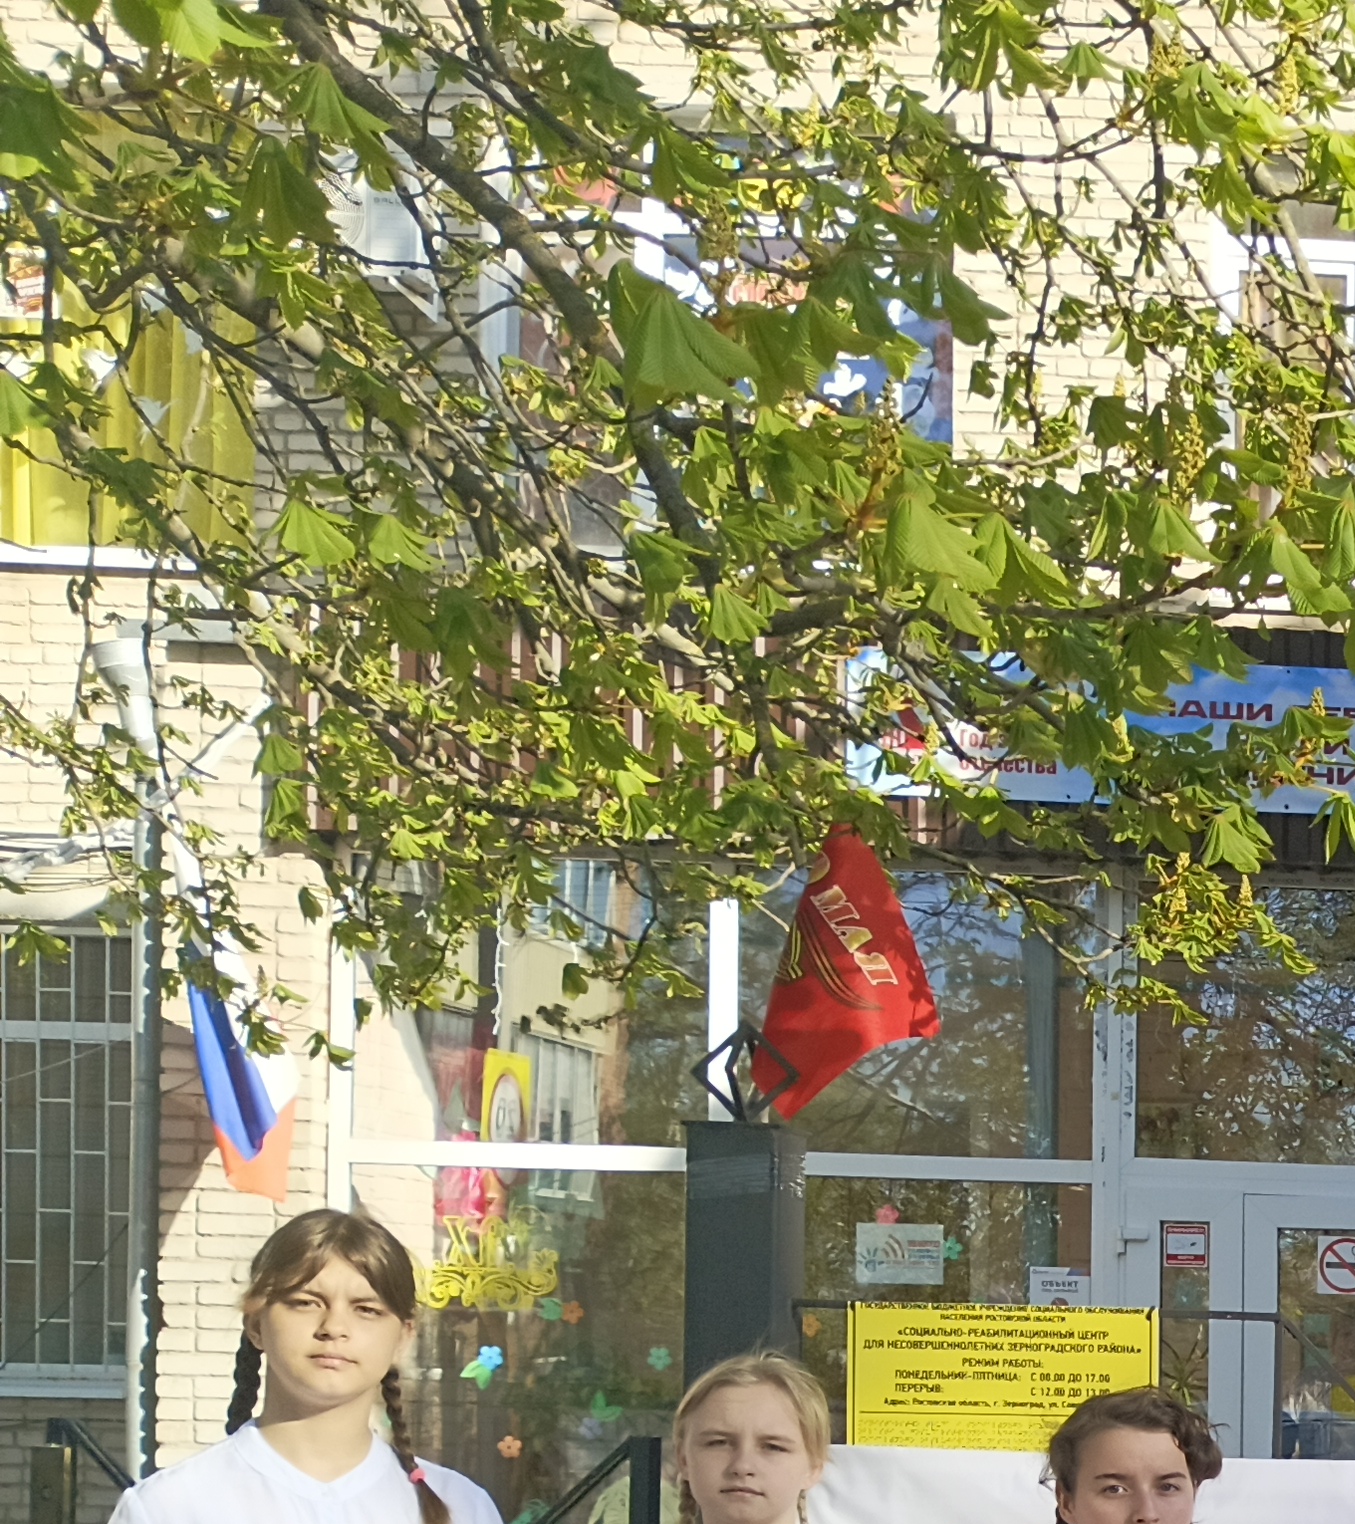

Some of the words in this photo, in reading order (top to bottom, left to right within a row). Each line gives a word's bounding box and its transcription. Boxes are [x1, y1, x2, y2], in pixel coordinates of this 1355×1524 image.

[1078, 1331, 1109, 1340] ЦЕНТР
[863, 1340, 884, 1349] ДЛЯ
[887, 1340, 1004, 1351] НЕСОВЕРШЕННОЛЕТНИХ
[962, 1358, 999, 1367] РЕЖИМ
[1067, 1373, 1082, 1383] ДО
[895, 1383, 944, 1393] ПЕРЕРЫВ:
[1067, 1388, 1082, 1398] ДО
